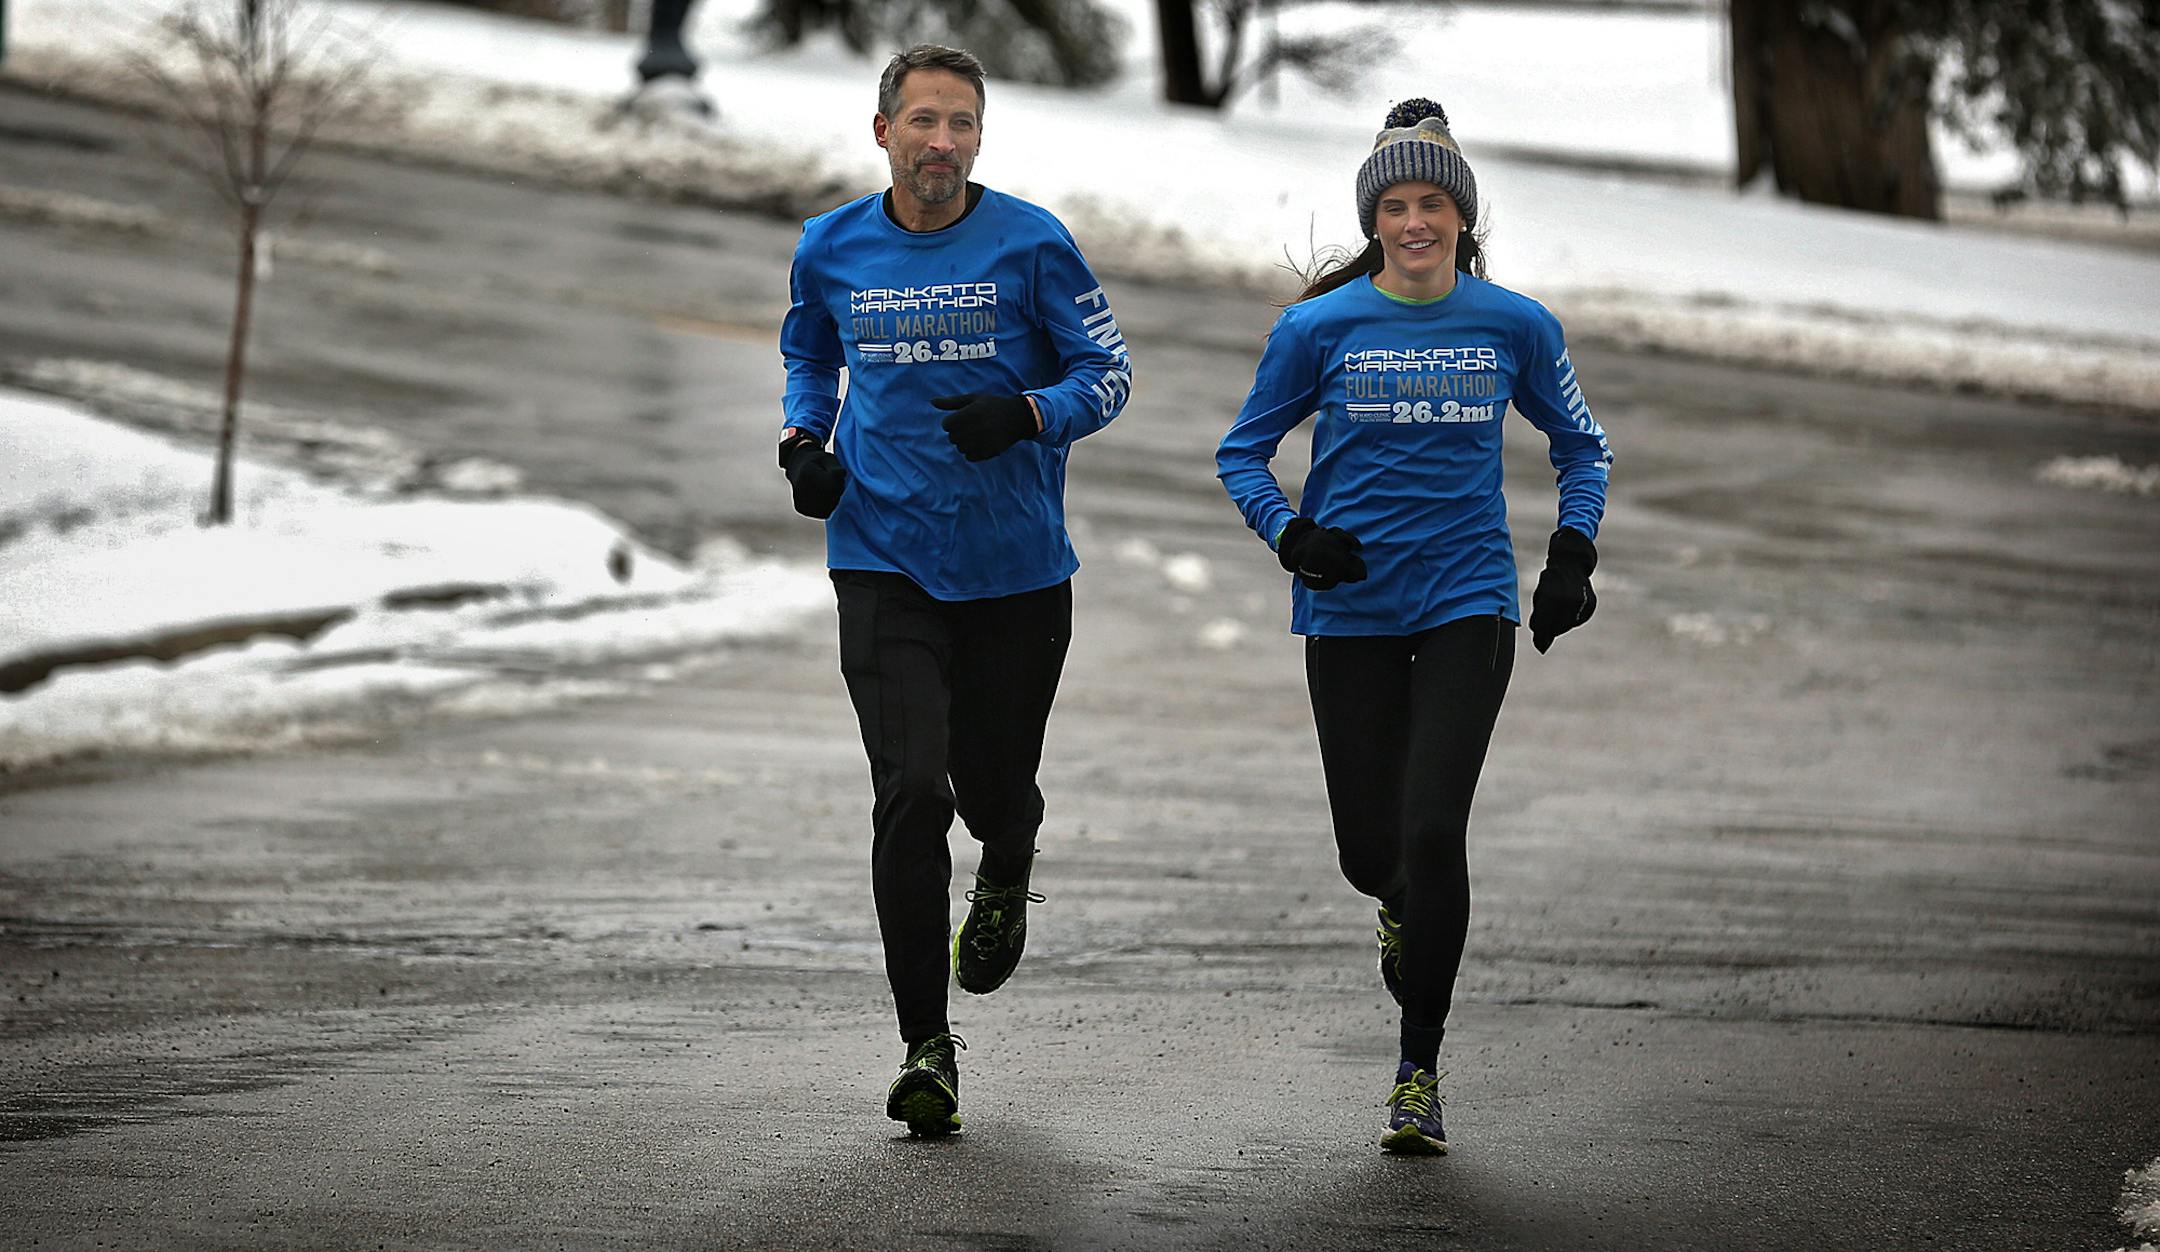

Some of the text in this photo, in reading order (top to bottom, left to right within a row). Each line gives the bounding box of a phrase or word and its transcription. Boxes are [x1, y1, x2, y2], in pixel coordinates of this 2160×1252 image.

[850, 282, 996, 302] MANKATO
[851, 295, 997, 314] MARATHON
[852, 310, 996, 341] FULL MARATHON
[893, 338, 998, 364] 26.2mi
[1074, 286, 1132, 418] FINIER
[1344, 347, 1497, 362] MANKATO
[1345, 360, 1497, 373] MARATHON
[1345, 374, 1496, 399] FULL MARATHON
[1392, 400, 1495, 424] 26.2mi
